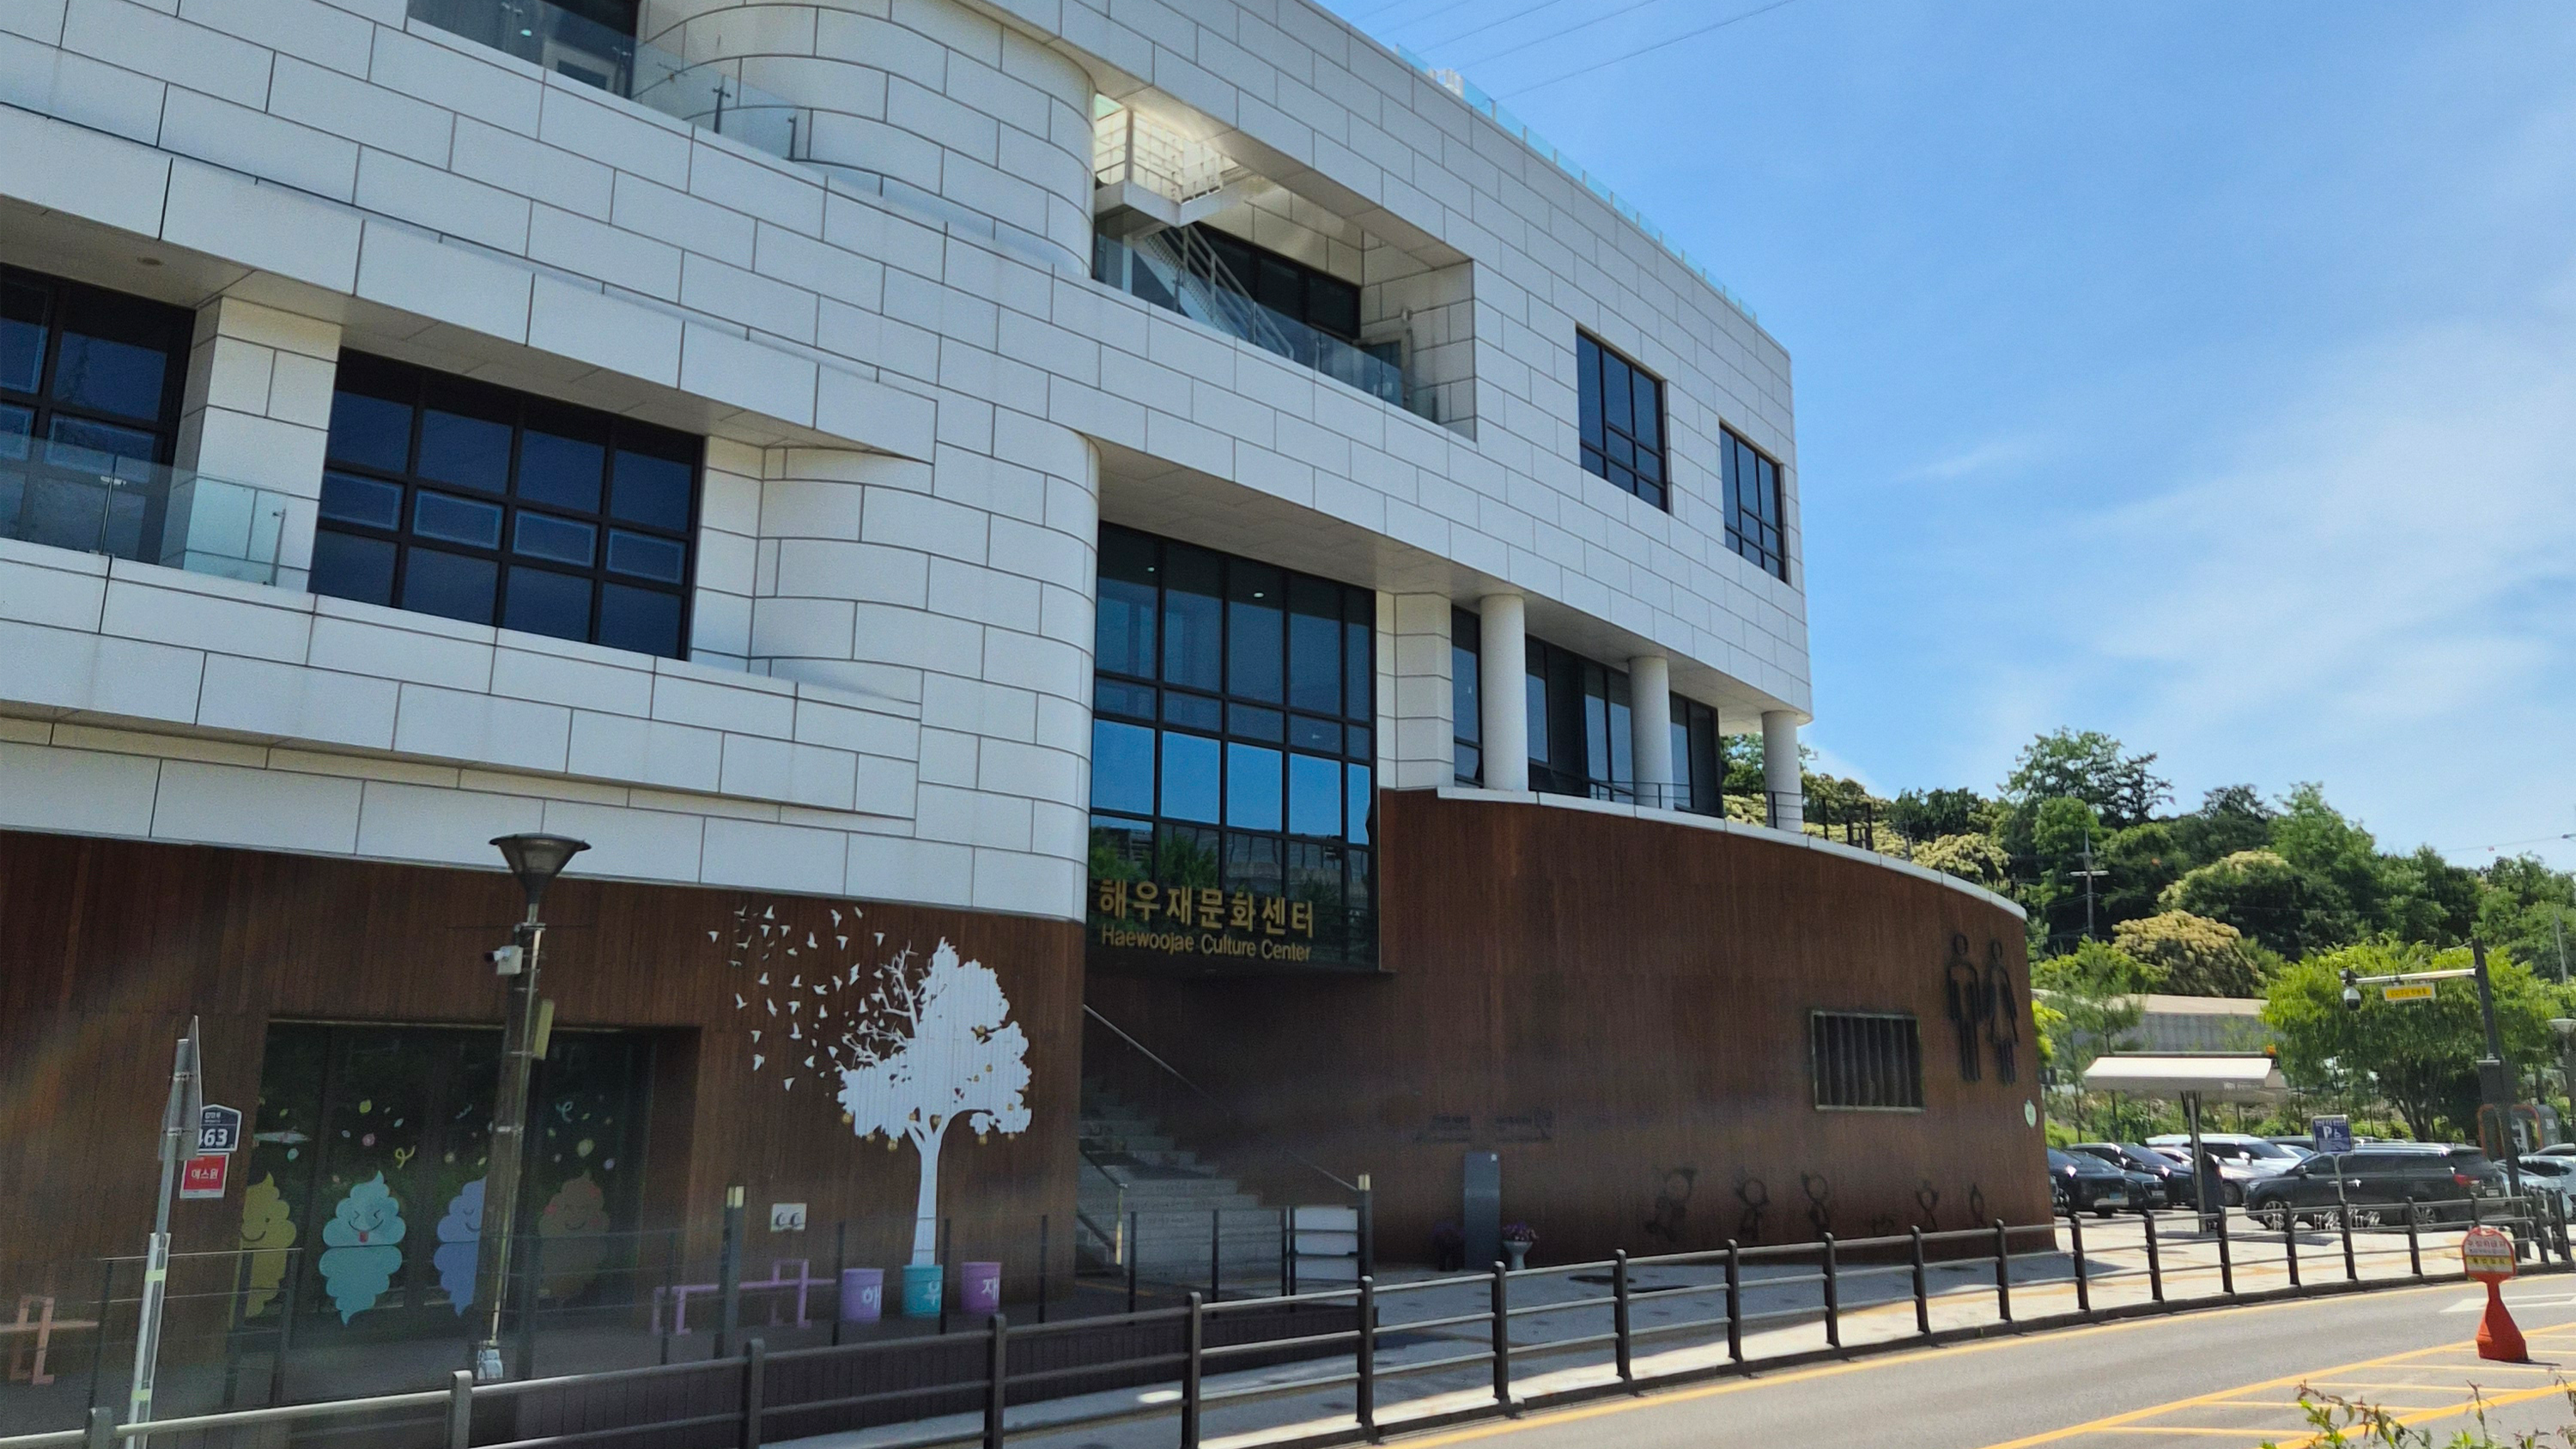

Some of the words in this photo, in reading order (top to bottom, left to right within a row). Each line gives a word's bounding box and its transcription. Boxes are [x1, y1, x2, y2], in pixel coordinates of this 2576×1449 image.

[1099, 879, 1313, 938] 해우재문화센터
[1102, 924, 1194, 955] Haewoojae
[1201, 933, 1256, 958] Culture
[1261, 938, 1312, 961] Center
[981, 1276, 1000, 1300] 재
